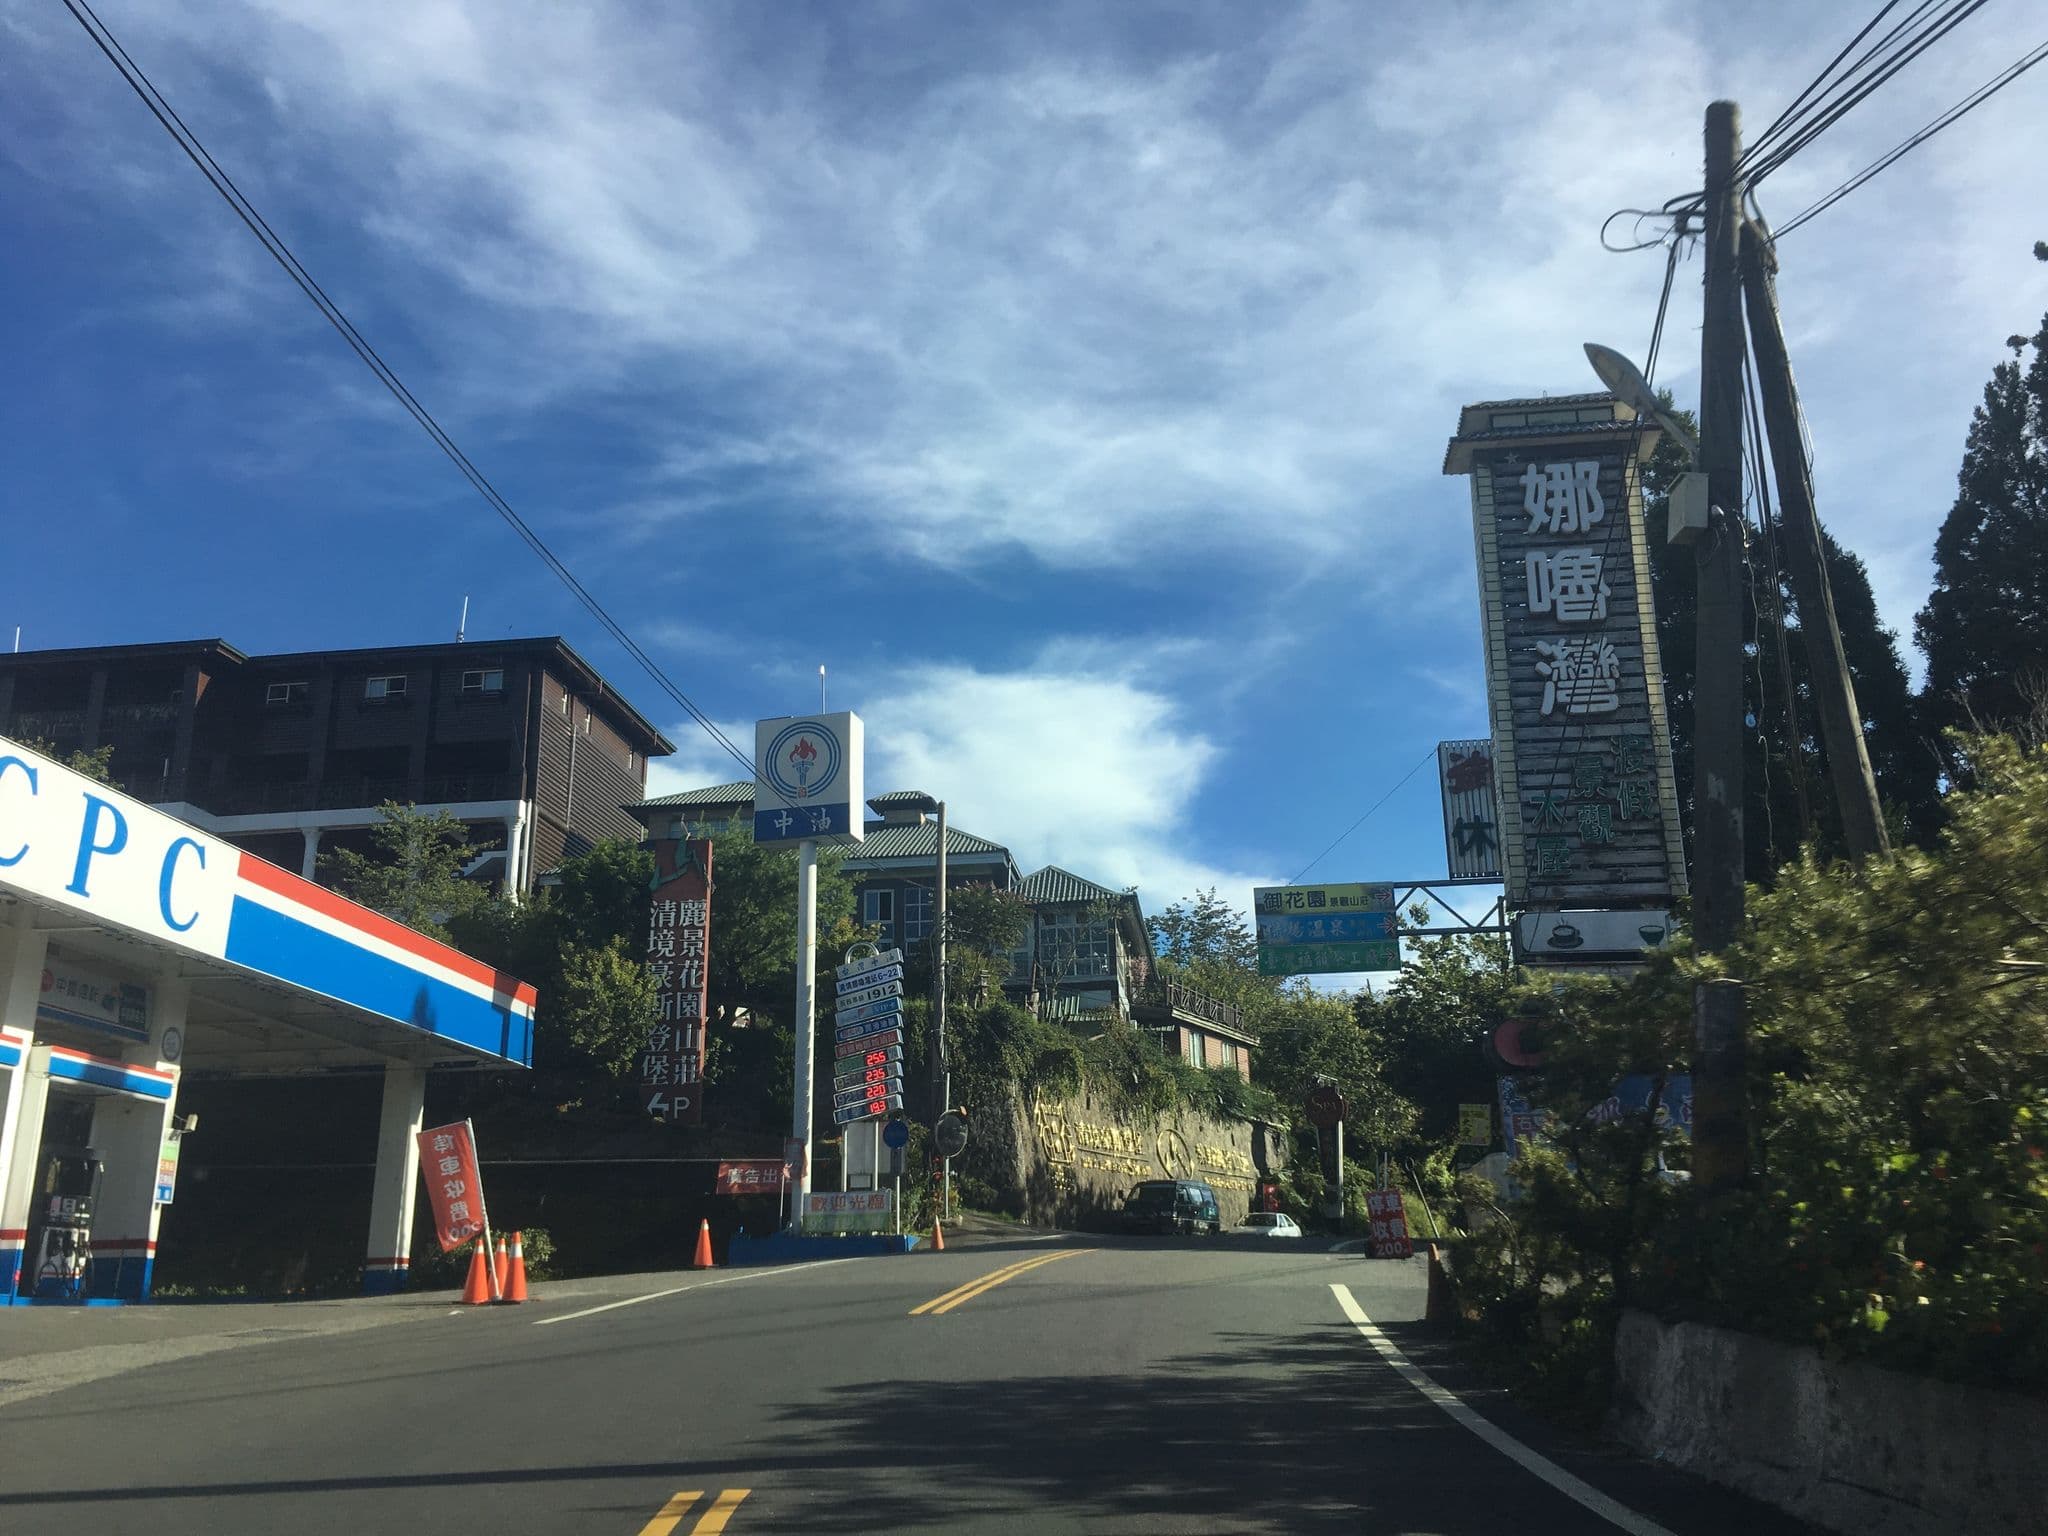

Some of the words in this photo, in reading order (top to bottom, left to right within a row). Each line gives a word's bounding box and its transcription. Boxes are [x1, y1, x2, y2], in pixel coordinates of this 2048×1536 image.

[1519, 461, 1620, 715] 娜嚕灣
[774, 808, 832, 837] 中油
[1529, 795, 1574, 876] 木屋
[1573, 755, 1617, 843] 景觀
[0, 756, 206, 932] CPC
[1263, 890, 1326, 911] 御花園
[672, 898, 706, 1085] 麗景花園山莊
[867, 983, 897, 1001] 1912
[673, 1097, 691, 1119] P
